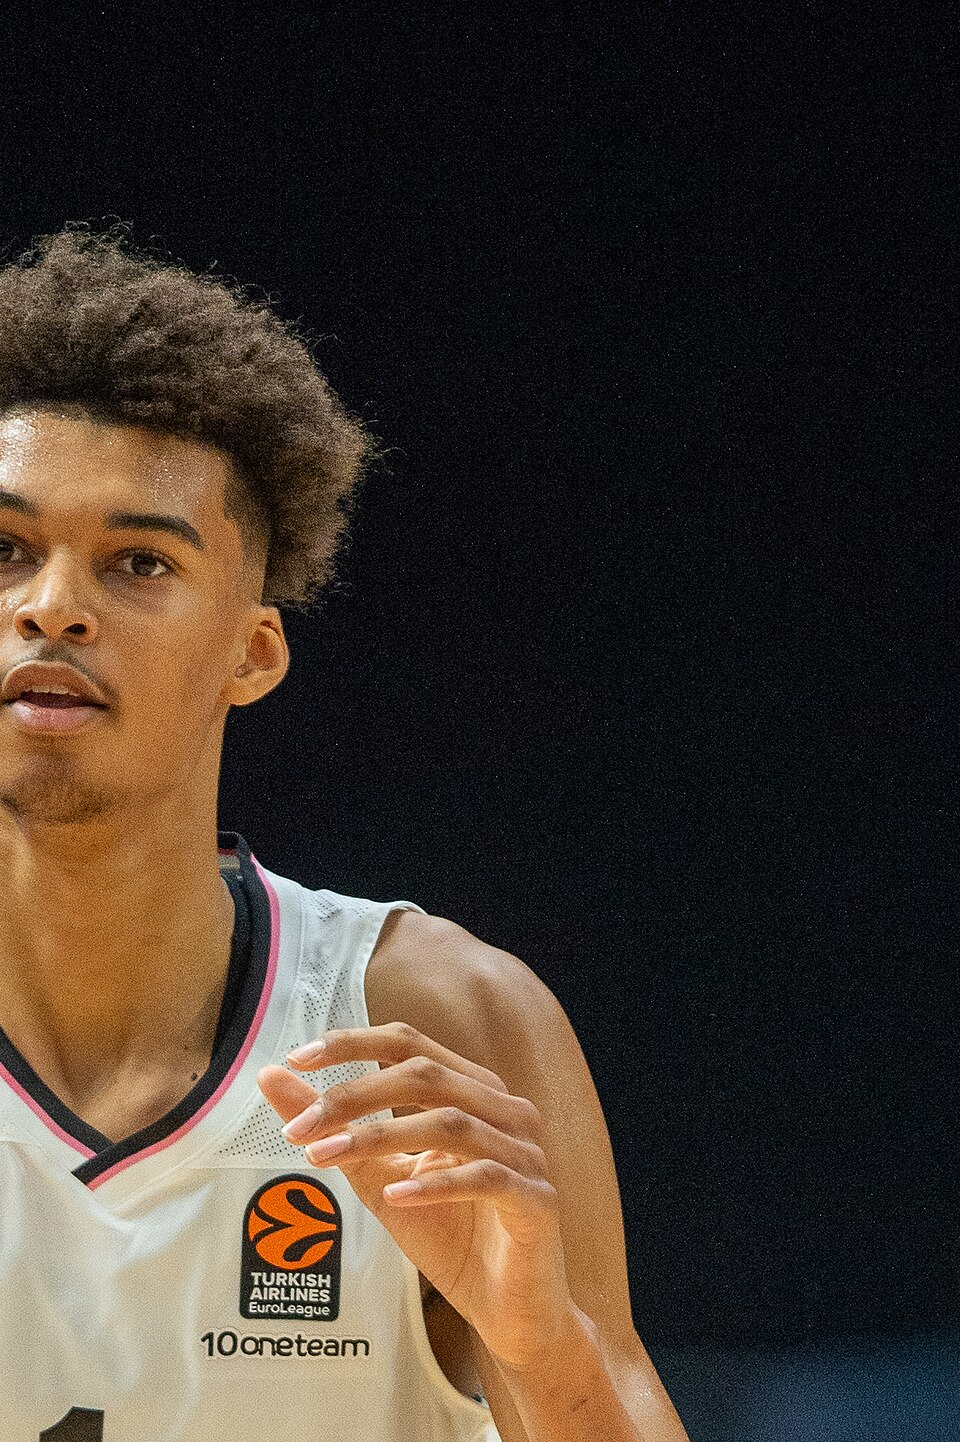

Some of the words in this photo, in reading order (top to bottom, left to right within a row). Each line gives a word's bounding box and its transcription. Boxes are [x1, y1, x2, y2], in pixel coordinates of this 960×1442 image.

[251, 1272, 331, 1288] TURKISH
[250, 1287, 331, 1303] AIRLINES
[249, 1302, 330, 1317] EuroLeague
